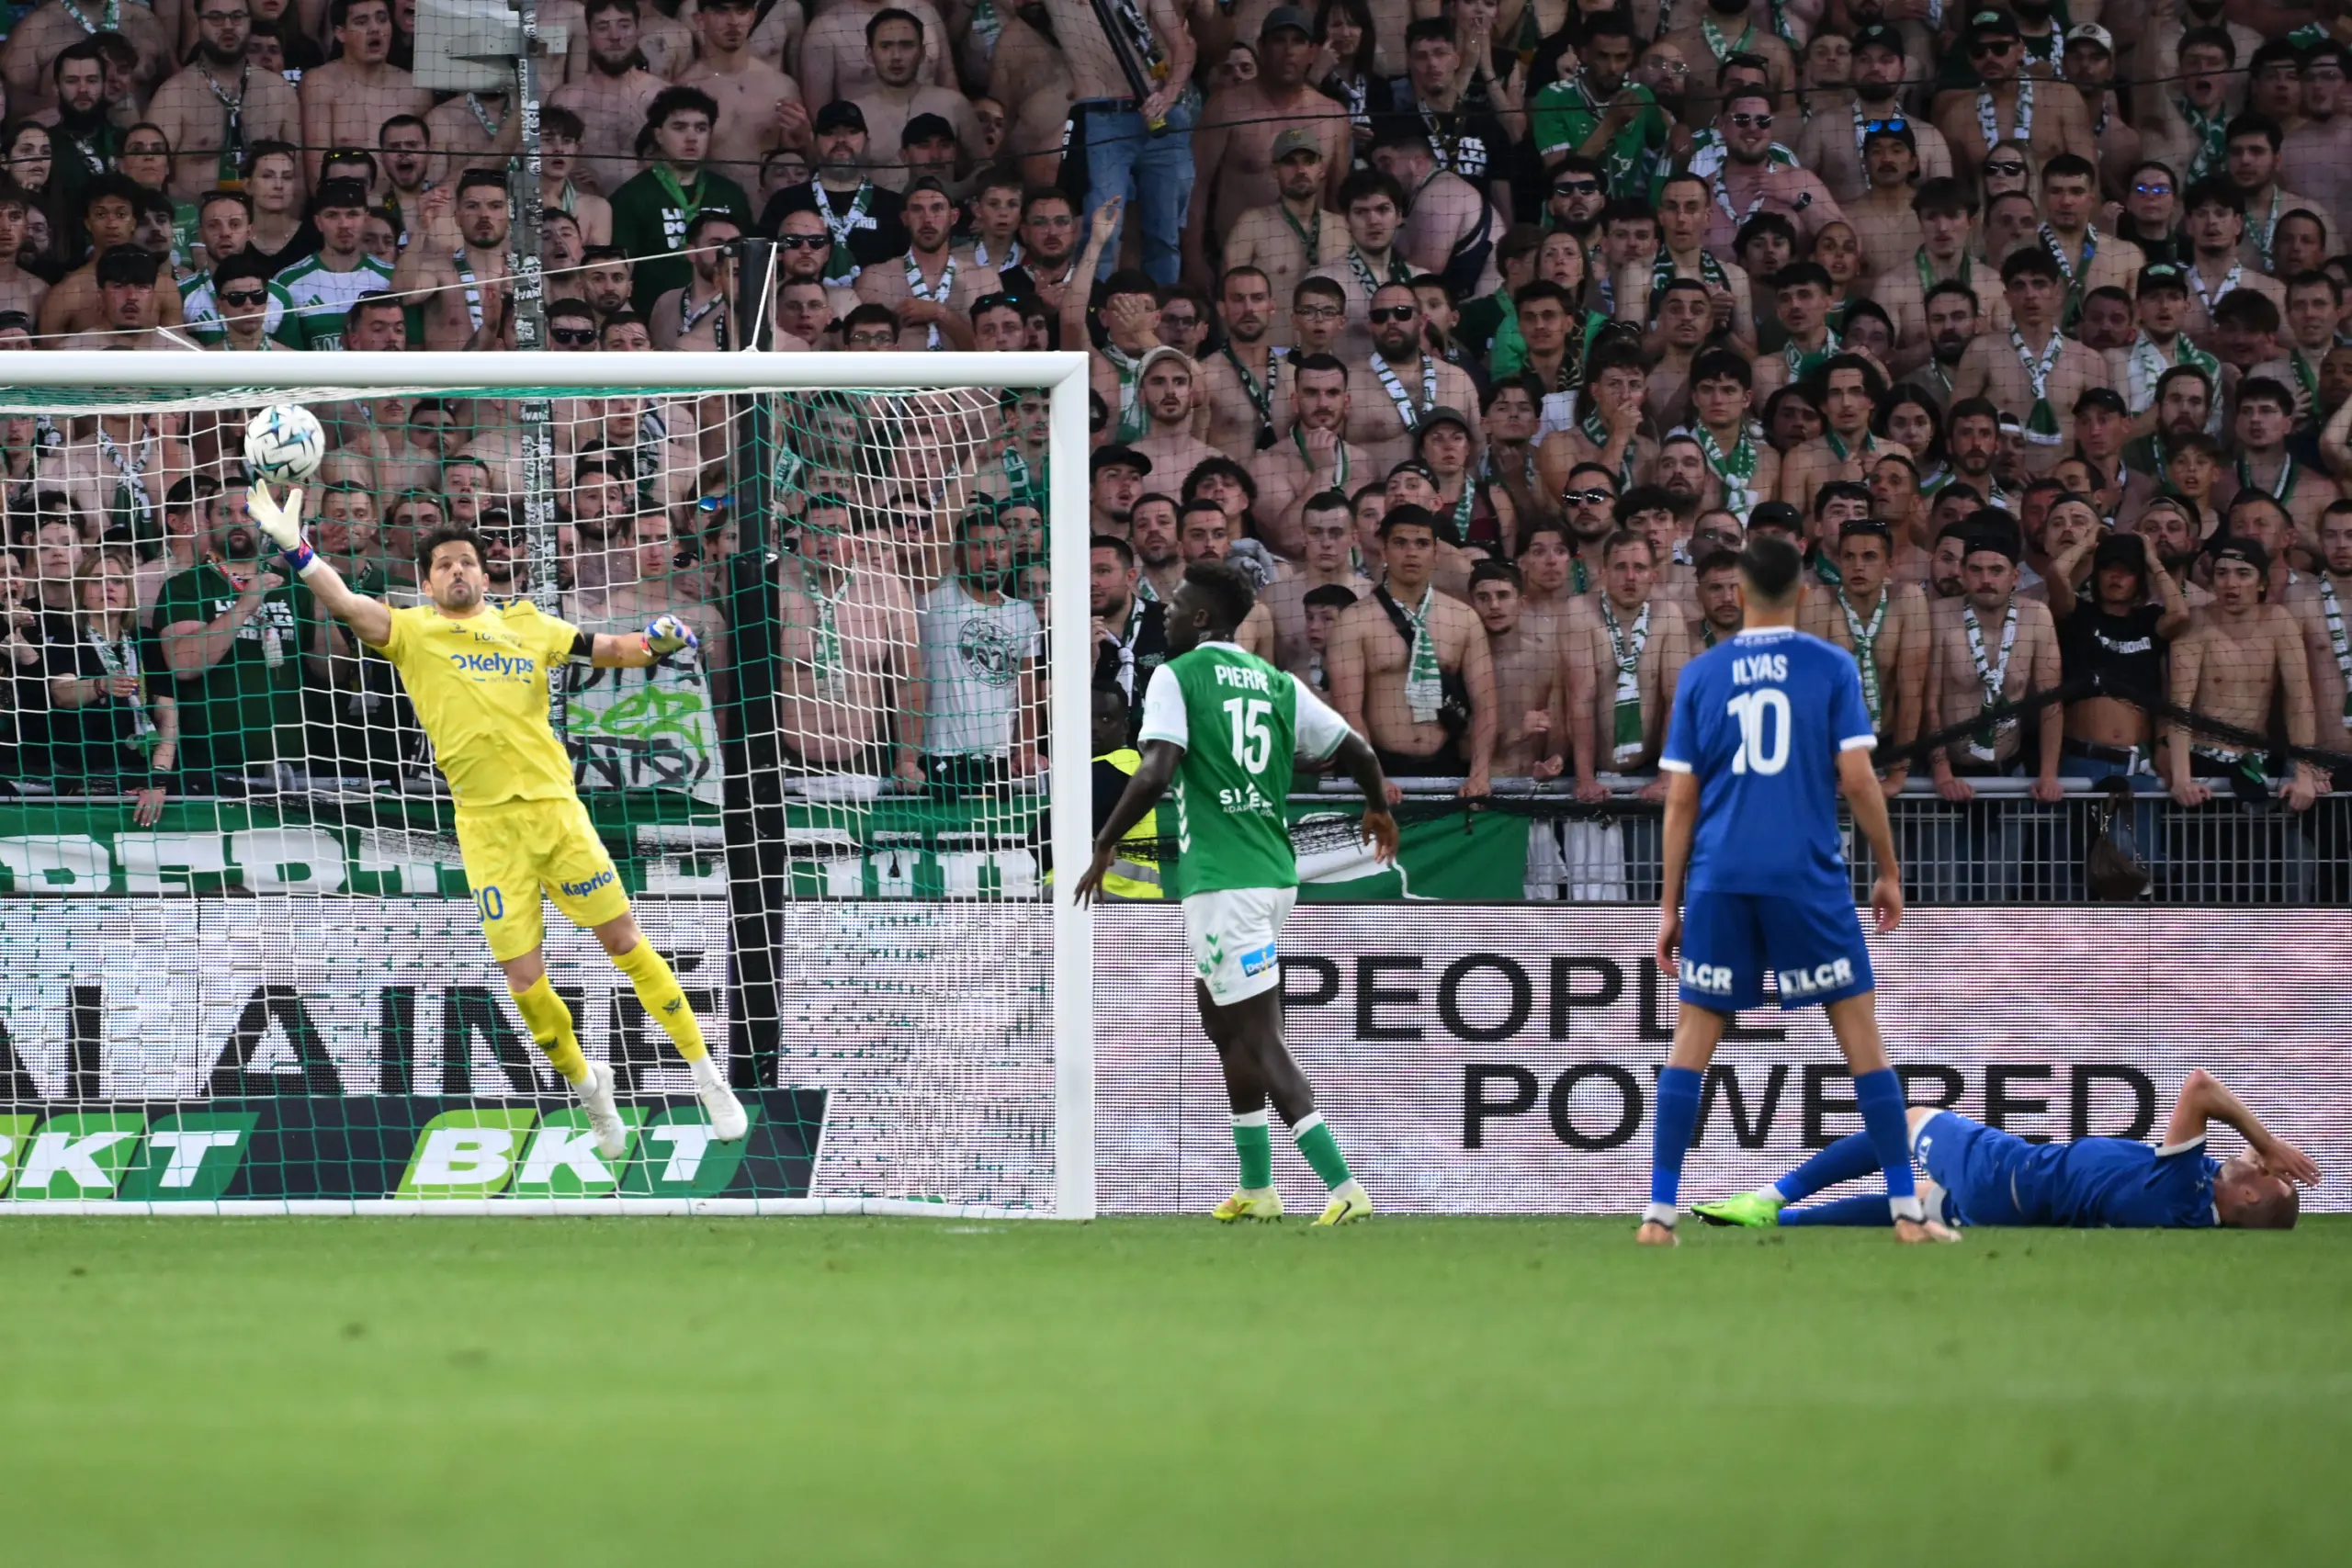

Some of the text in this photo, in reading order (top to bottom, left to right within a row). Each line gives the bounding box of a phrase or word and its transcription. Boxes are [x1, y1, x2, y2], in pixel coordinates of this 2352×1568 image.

[467, 652, 534, 675] Kelyps
[1733, 653, 1788, 685] ILYAS
[1223, 697, 1272, 774] 15
[1727, 688, 1791, 776] 10
[1685, 960, 1733, 989] LCR
[1799, 957, 1854, 987] LCR
[411, 1124, 726, 1185] BKT
